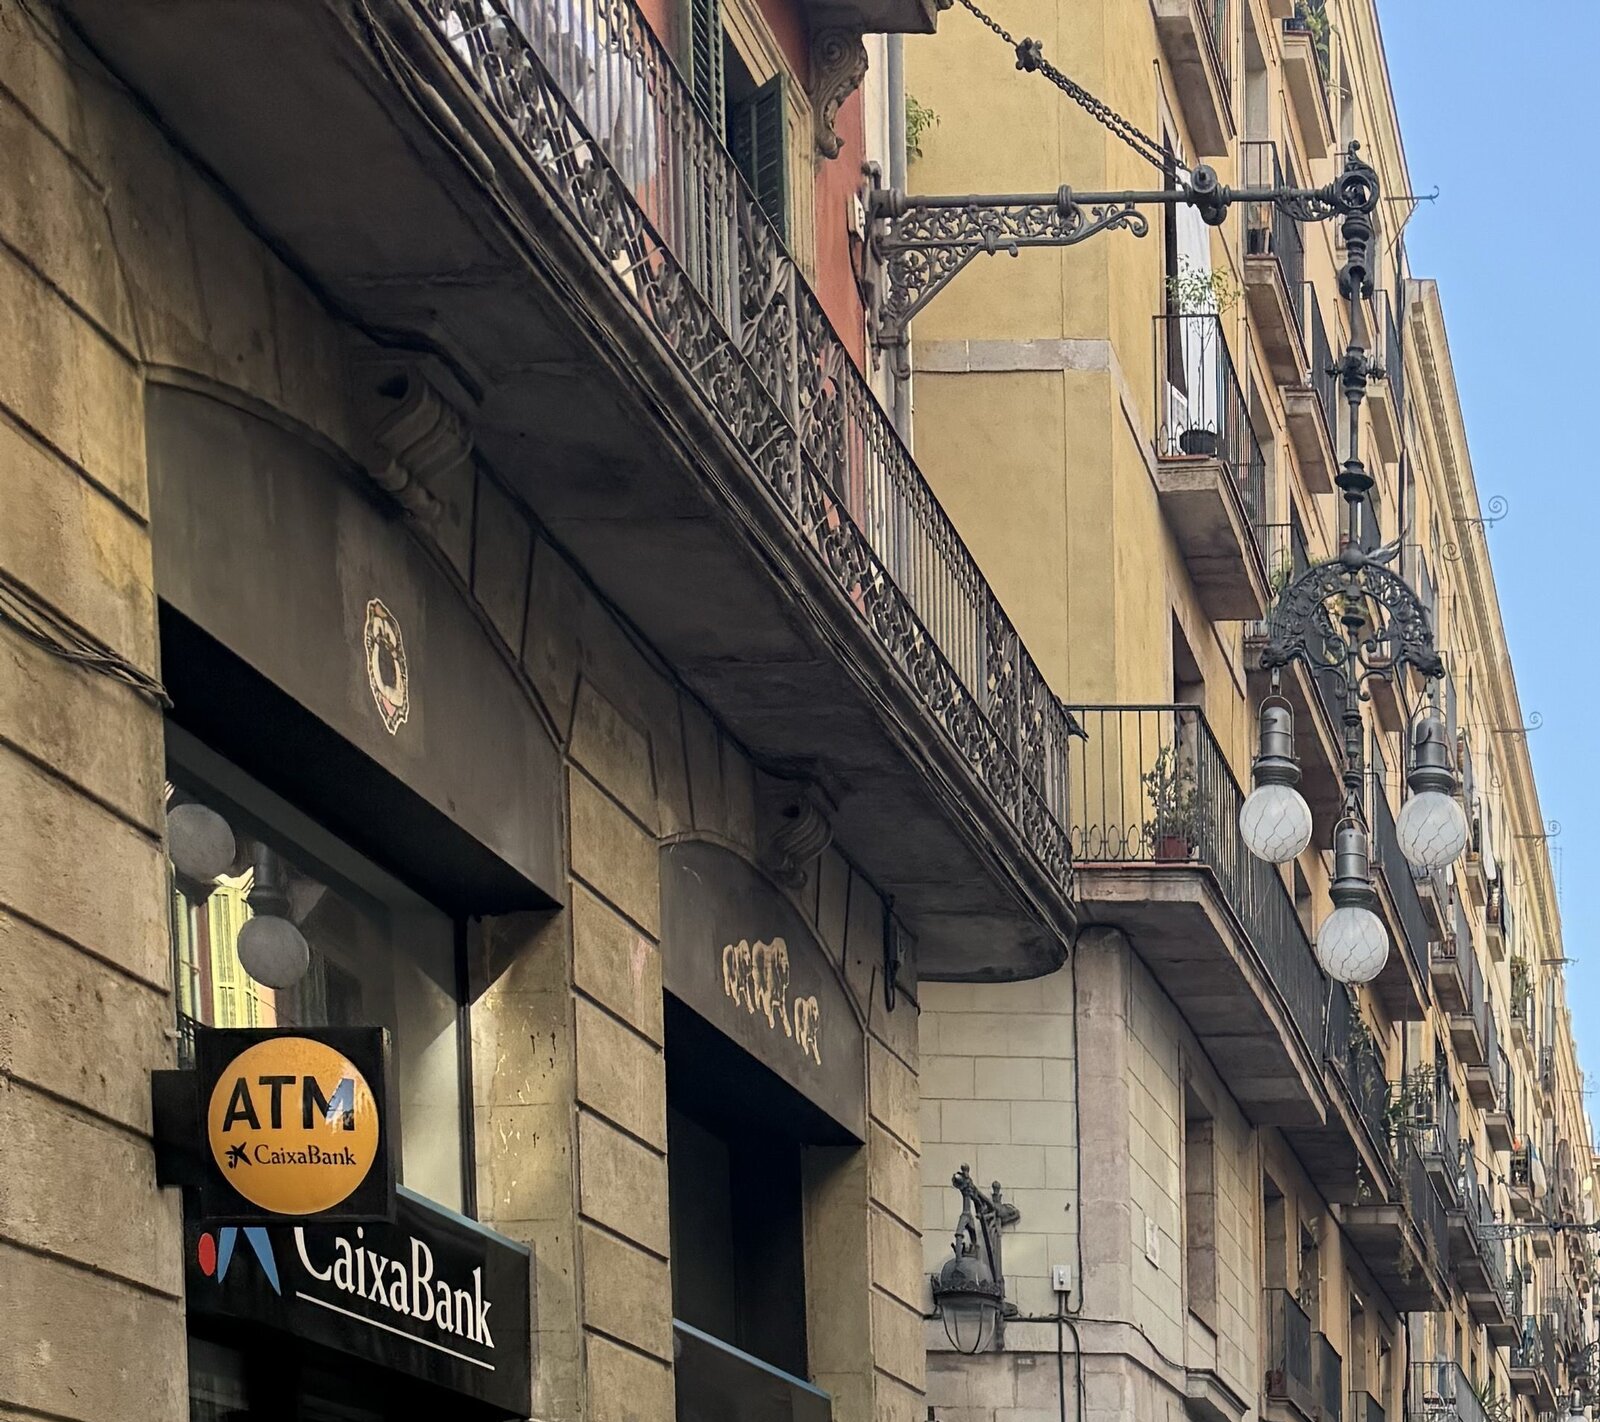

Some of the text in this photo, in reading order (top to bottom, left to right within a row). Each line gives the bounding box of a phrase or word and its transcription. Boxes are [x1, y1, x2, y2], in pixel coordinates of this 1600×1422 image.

[222, 1076, 355, 1132] ATM
[254, 1144, 357, 1167] CaixaBank
[294, 1227, 495, 1348] CaixaBank
